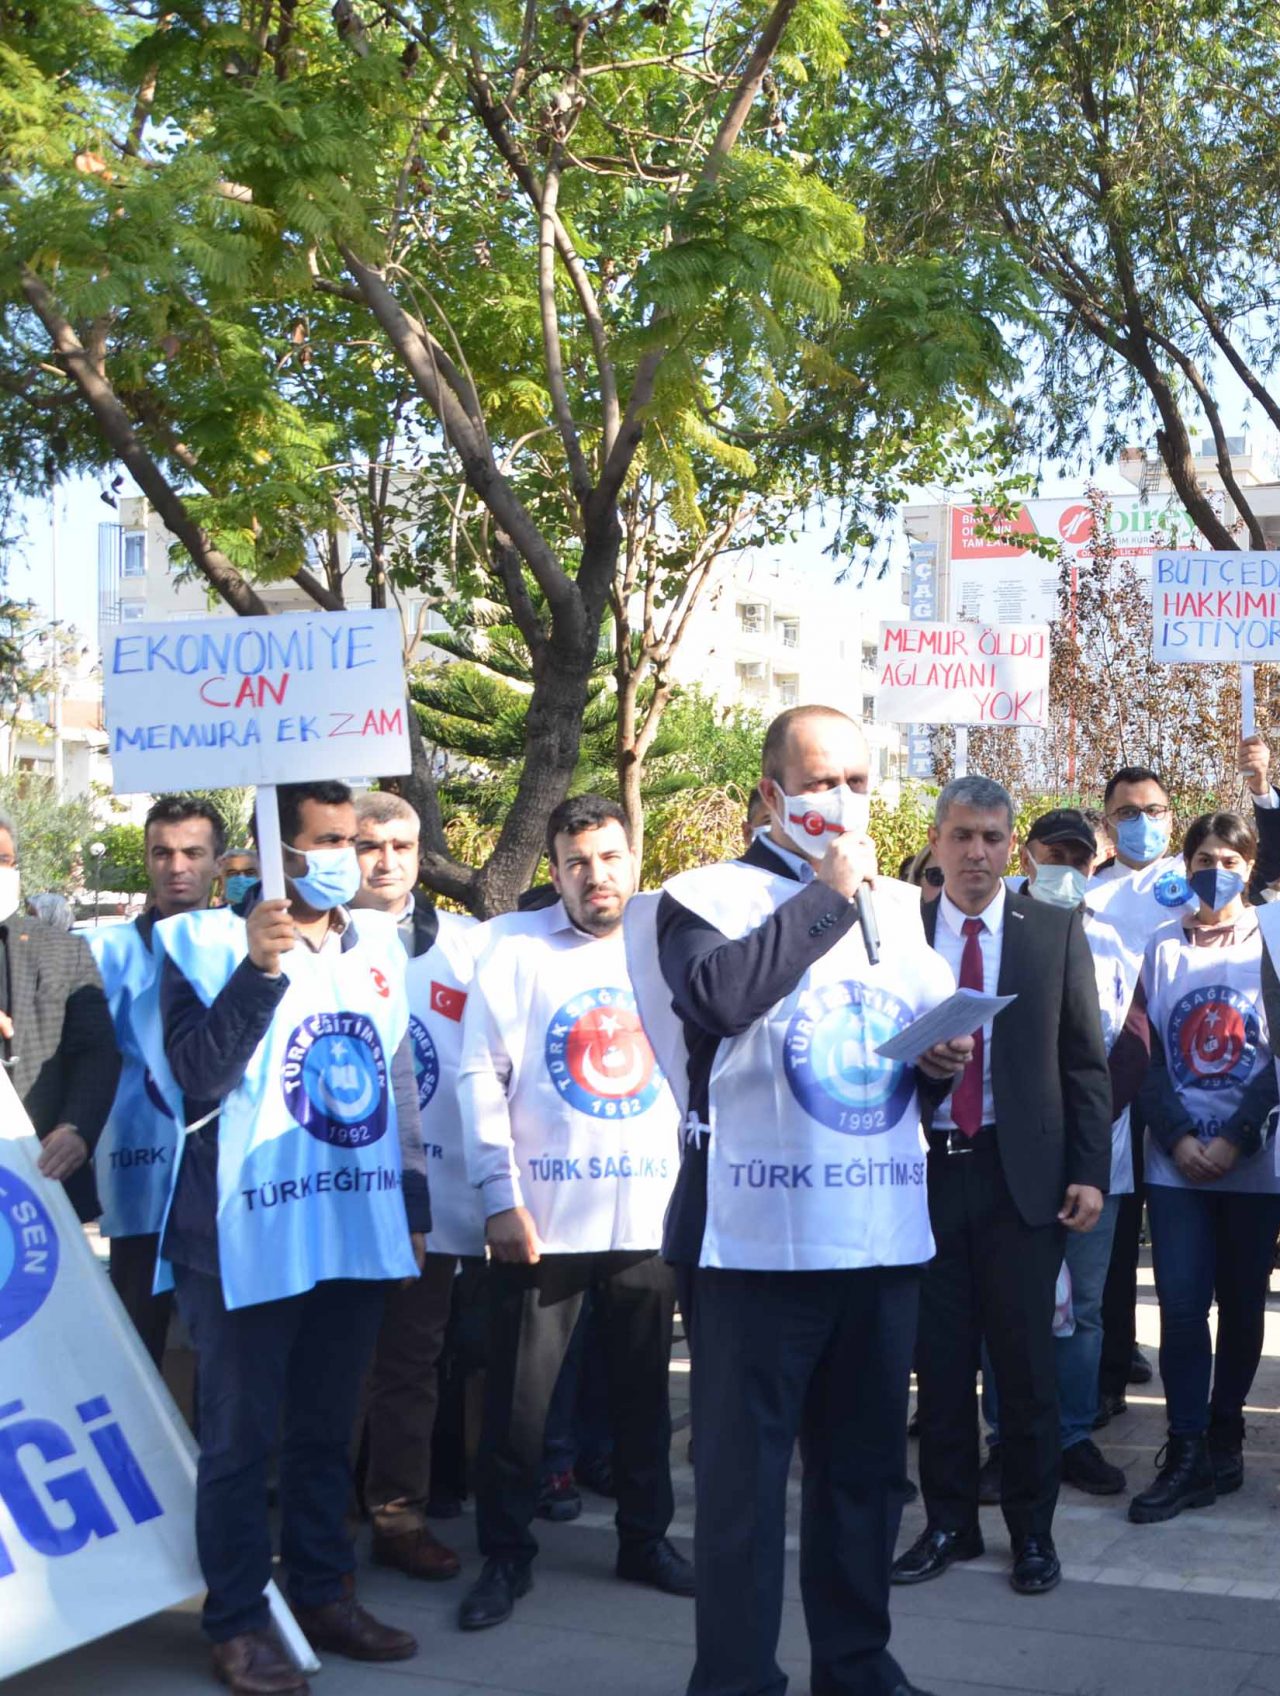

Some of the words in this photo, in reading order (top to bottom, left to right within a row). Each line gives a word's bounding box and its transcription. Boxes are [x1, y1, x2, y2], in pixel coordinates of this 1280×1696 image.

[112, 621, 378, 676] EKONOMİYE
[883, 627, 969, 656] MEMUR
[977, 626, 1046, 660] ÖLDÜ
[199, 672, 291, 709] CAN
[972, 690, 1044, 725] YOK!
[114, 717, 262, 753] MEMURA
[276, 715, 321, 743] EK
[327, 708, 404, 739] ZAM
[838, 1110, 887, 1130] 1992
[728, 1159, 814, 1189] TÜRK
[12, 1199, 48, 1275] SEN
